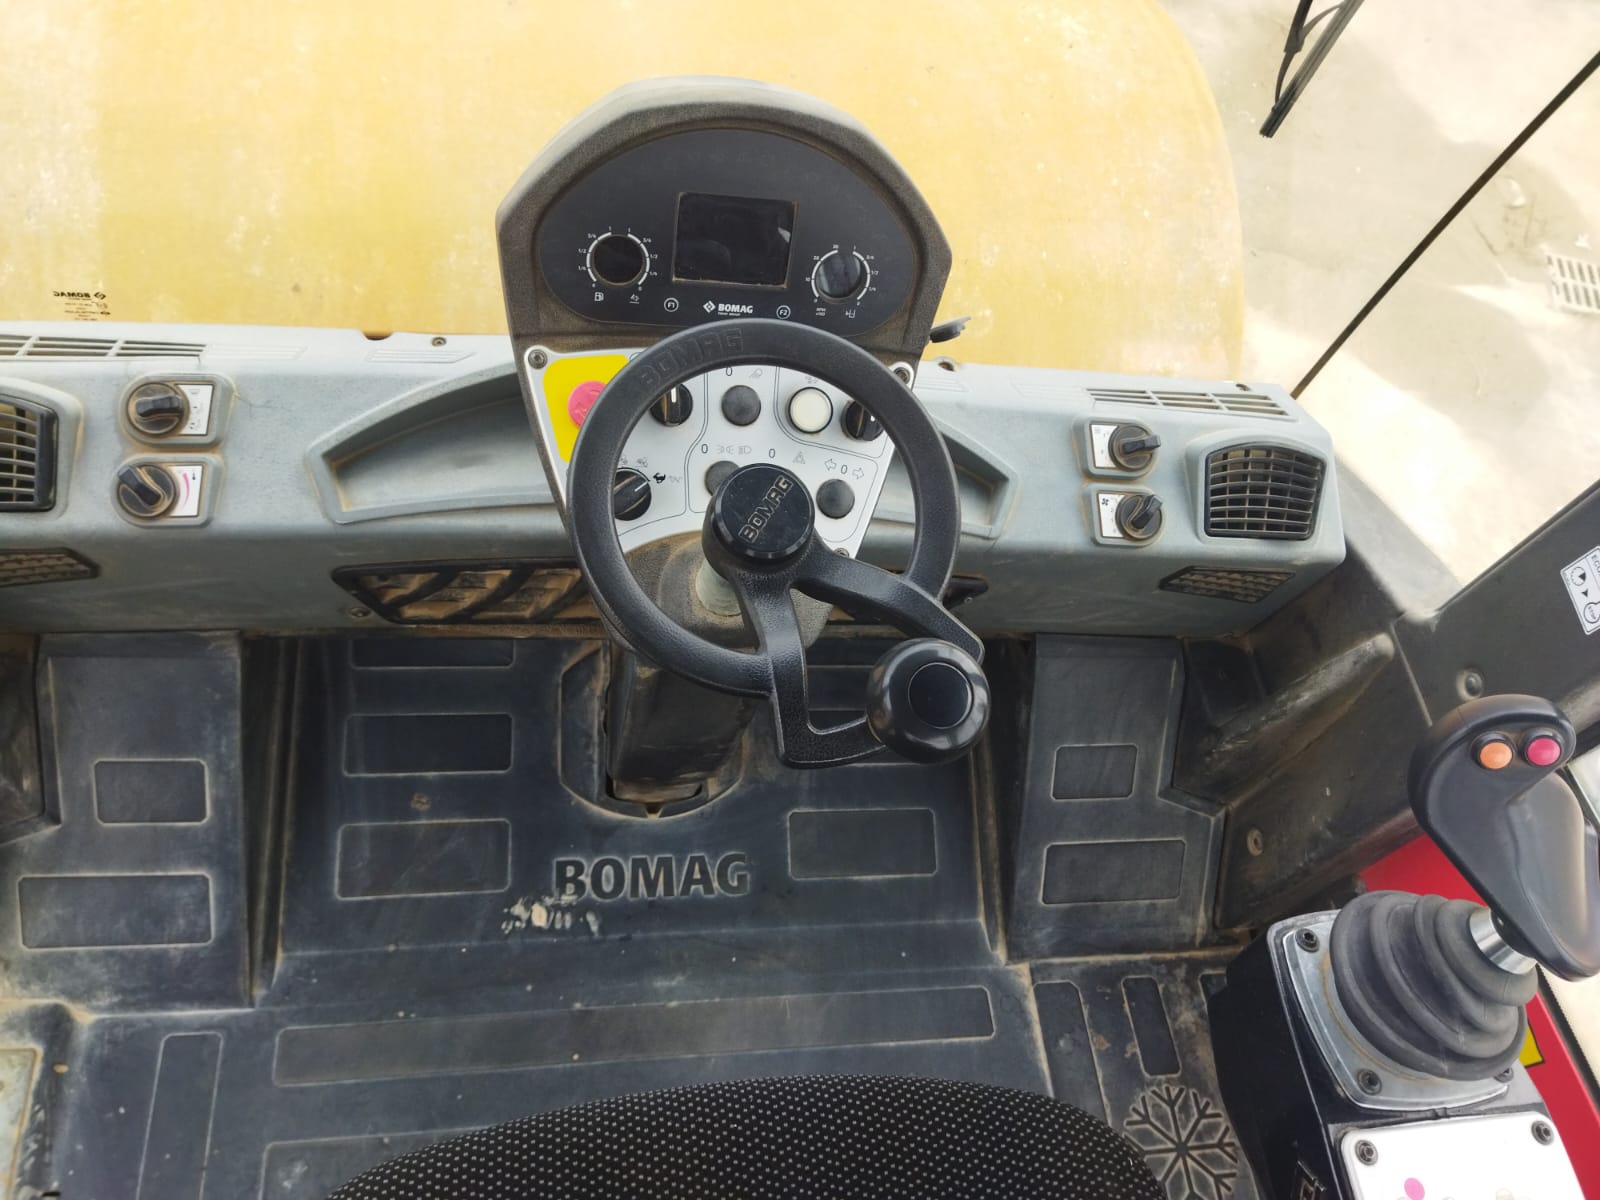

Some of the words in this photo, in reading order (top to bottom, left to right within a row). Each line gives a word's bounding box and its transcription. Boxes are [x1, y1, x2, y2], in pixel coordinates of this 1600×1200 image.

[718, 303, 754, 314] BOMAG
[725, 366, 733, 377] 0
[701, 443, 709, 455] 0
[768, 448, 776, 459] 0
[841, 464, 849, 475] 0
[738, 474, 793, 544] BOMAG
[553, 851, 751, 902] BOMAG
